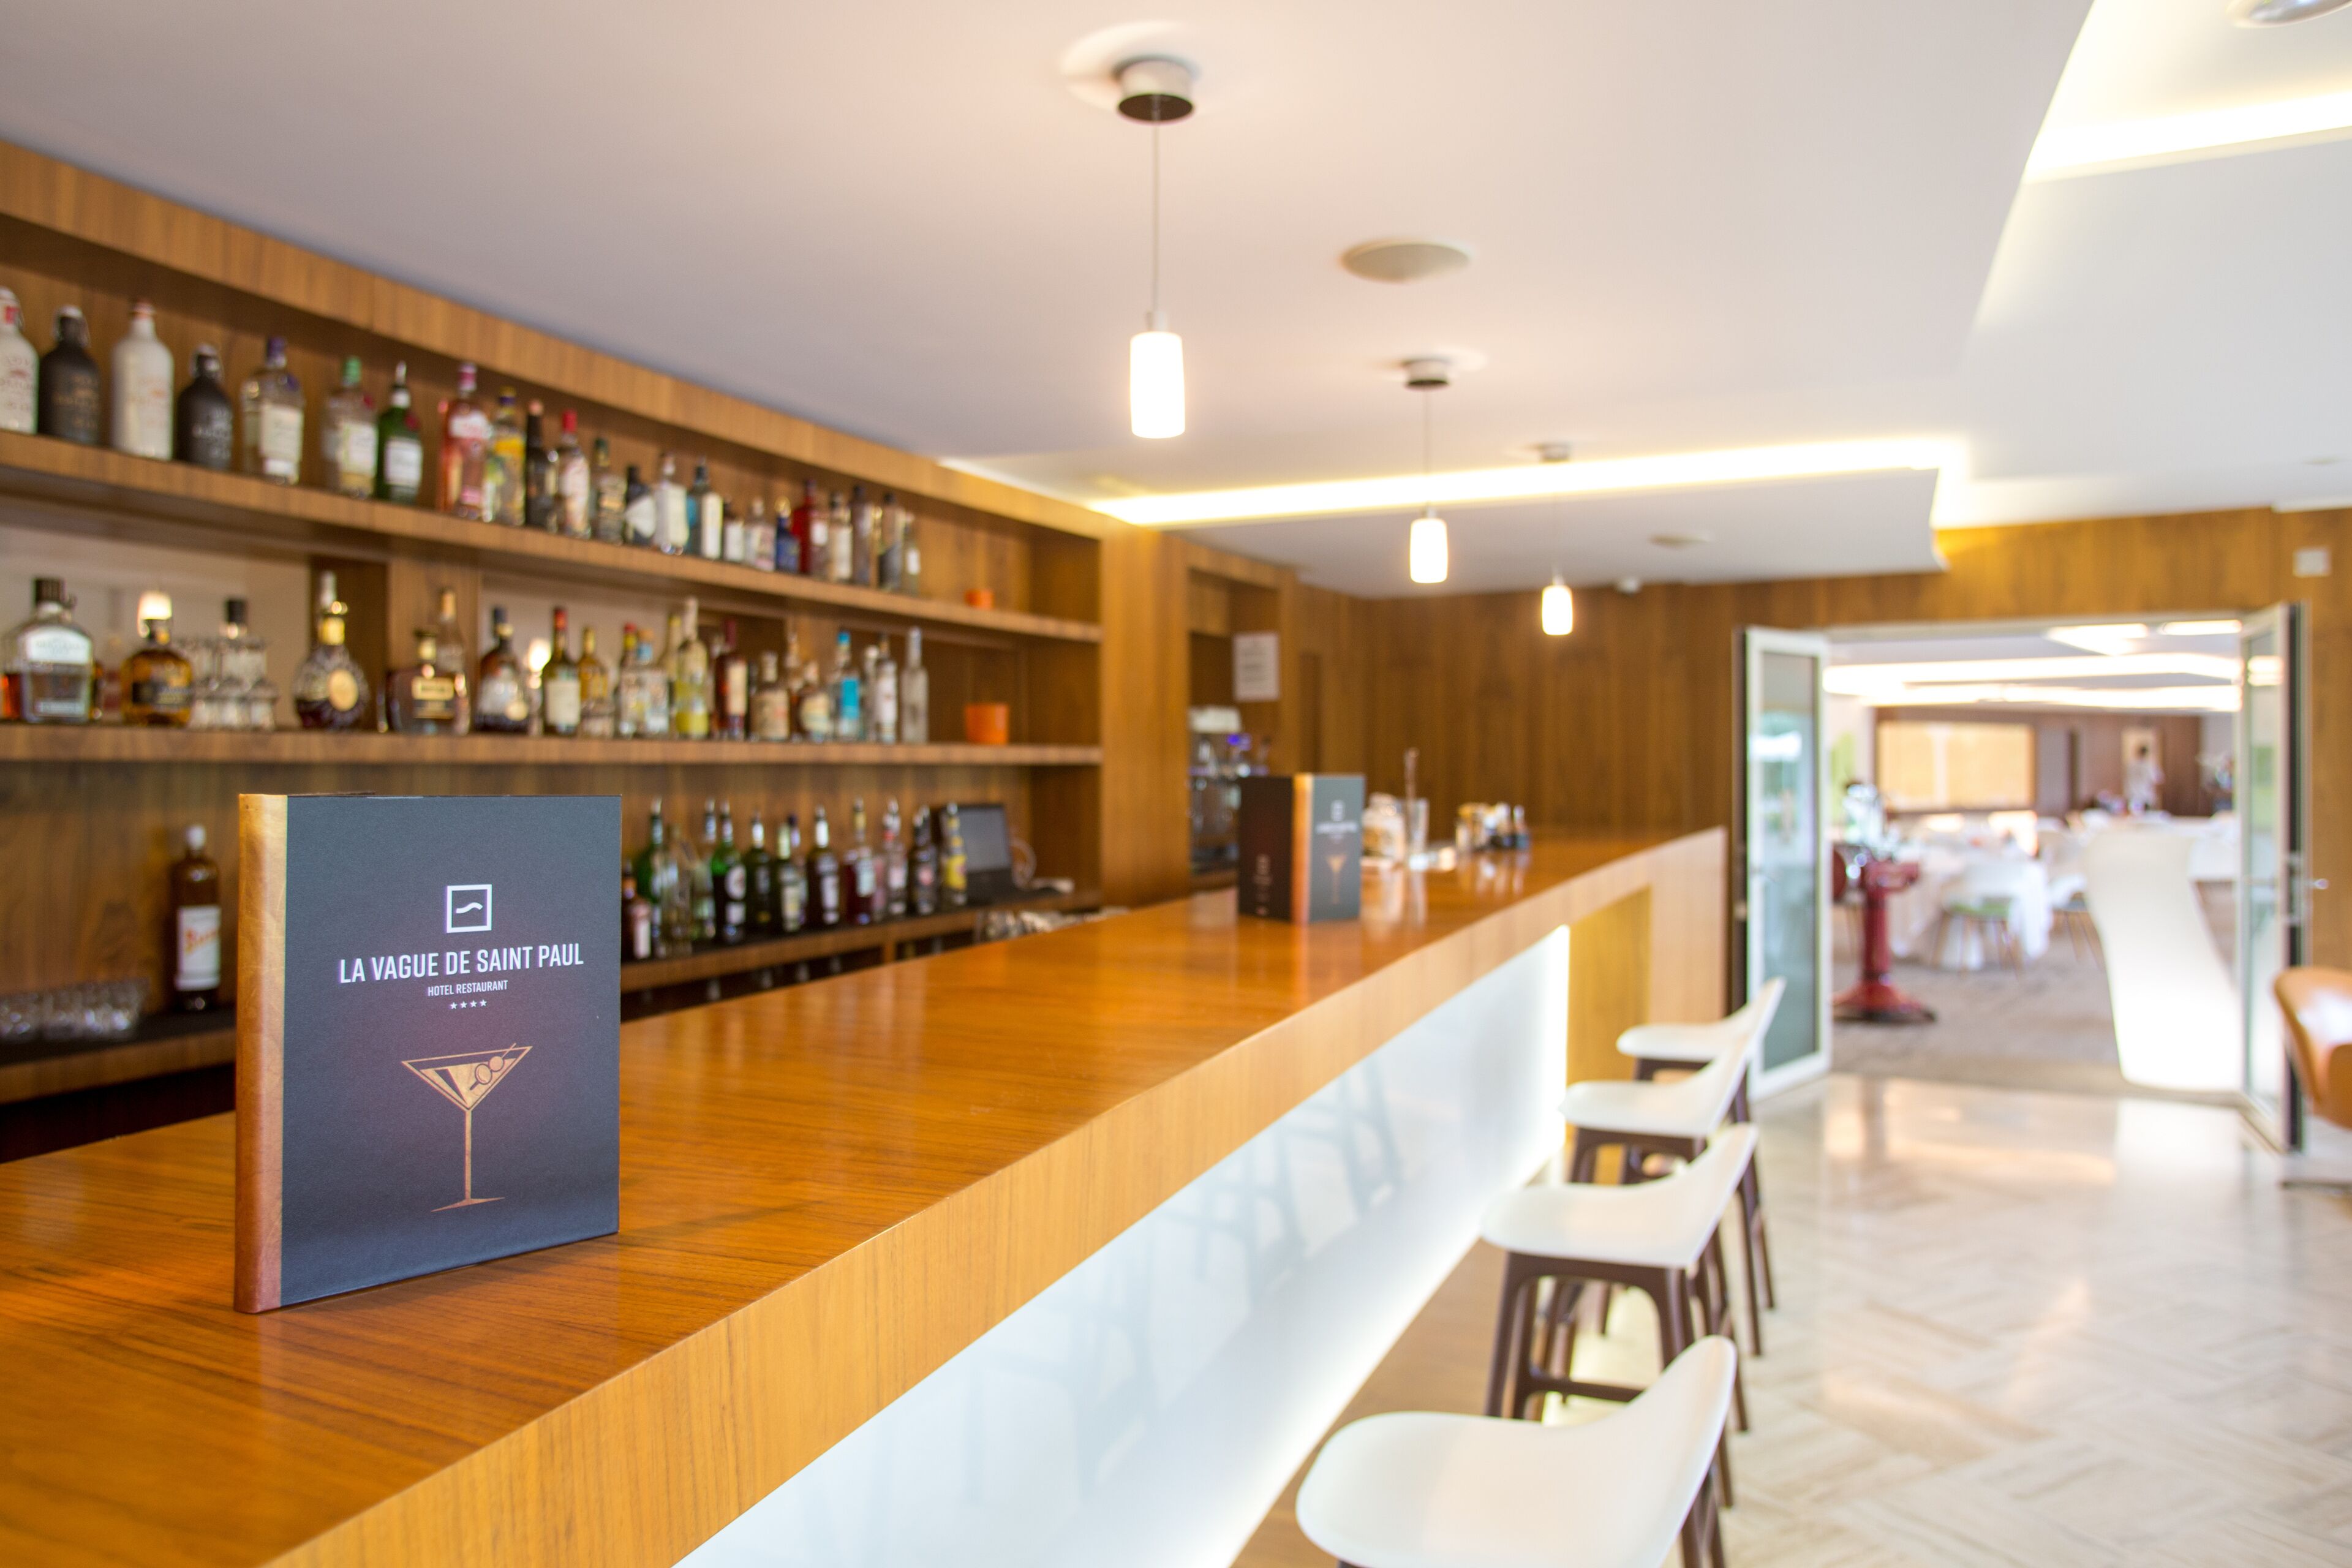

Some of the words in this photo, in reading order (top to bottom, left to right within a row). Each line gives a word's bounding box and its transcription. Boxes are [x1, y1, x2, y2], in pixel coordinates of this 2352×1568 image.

[339, 958, 366, 983] LA
[371, 952, 439, 980] VAGUE
[445, 950, 470, 976] DE
[477, 946, 533, 973] SAINT
[538, 943, 584, 968] PAUL
[428, 984, 454, 997] HOTEL
[456, 980, 508, 995] RESTAURANT
